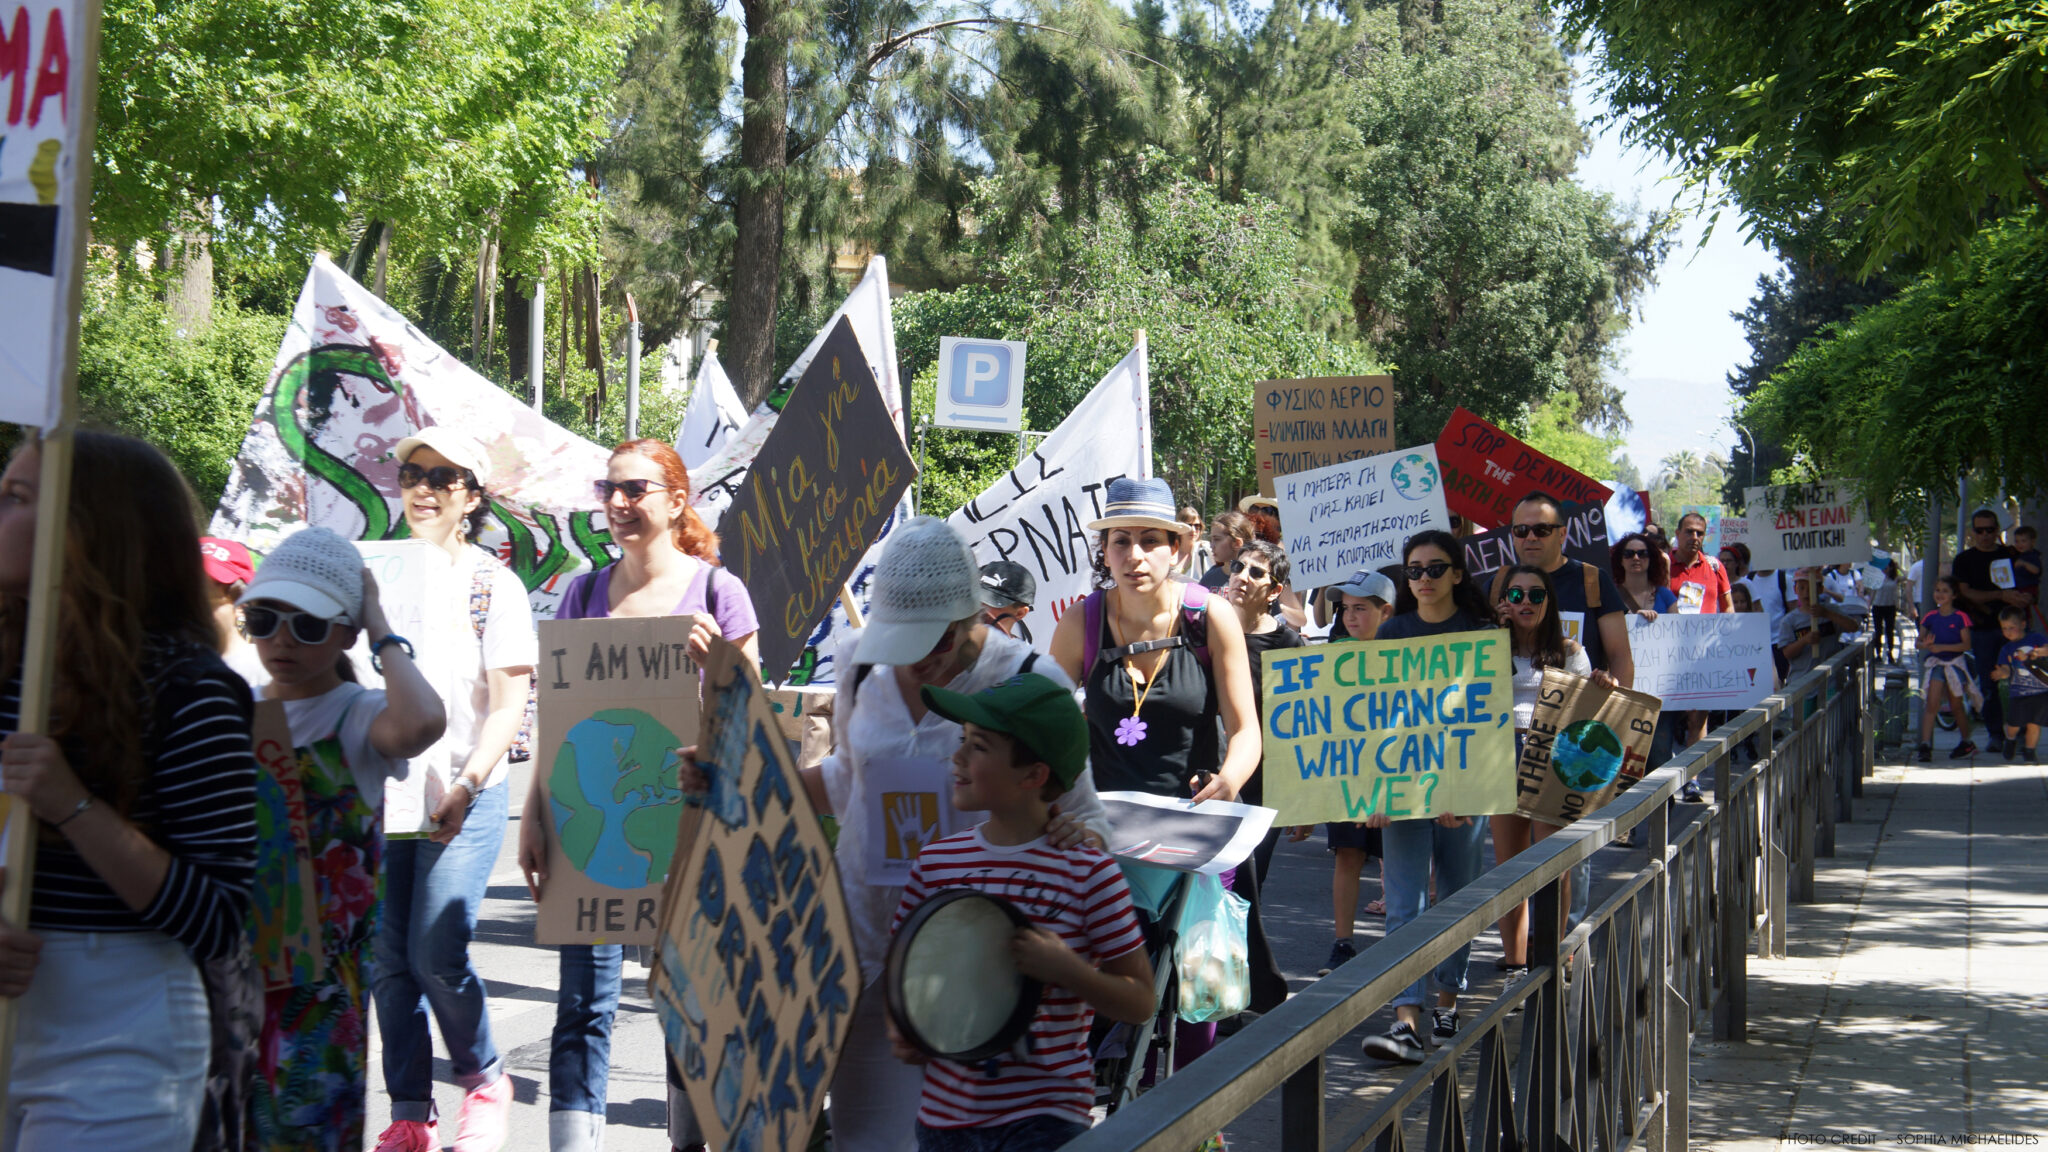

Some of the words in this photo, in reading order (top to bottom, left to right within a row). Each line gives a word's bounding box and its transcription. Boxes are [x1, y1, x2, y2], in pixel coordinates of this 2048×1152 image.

[964, 352, 1000, 397] P
[1266, 388, 1325, 411] ΦΥΣΙΚΟ
[1330, 386, 1384, 409] ΑΕΡΙΟ
[1453, 422, 1506, 456] STOP
[1512, 450, 1601, 504] DENYING
[1484, 458, 1517, 486] THE
[1287, 482, 1298, 501] Η
[1303, 471, 1352, 498] ΜΗΤΕΡΑ
[1357, 465, 1377, 486] ΓΗ
[1310, 500, 1342, 523] ΜΑΣ
[1491, 493, 1513, 515] IS
[1775, 508, 1806, 531] ΔΕΝ
[1809, 503, 1852, 528] ΕΙΝΑΙ
[1291, 535, 1312, 555] ΝΑ
[1318, 508, 1432, 548] ΣΤΑΜΑΤΗΣΟΥΜΕ
[1782, 528, 1846, 551] ΠΟΛΙΤΙΚΗ!
[1298, 555, 1327, 576] ΤΗΝ
[551, 648, 571, 690] I
[585, 641, 629, 681] AM
[1272, 654, 1324, 695] IF
[1334, 640, 1496, 687] CLIMATE
[1632, 646, 1660, 668] ΙΔΗ
[1270, 695, 1332, 739] CAN
[1343, 682, 1509, 732] CHANGE,
[1630, 717, 1653, 736] B
[1294, 738, 1366, 779] WHY
[1375, 726, 1476, 774] CAN'T
[1516, 718, 1558, 797] THERE
[1541, 687, 1565, 710] IS
[1558, 793, 1585, 822] NO
